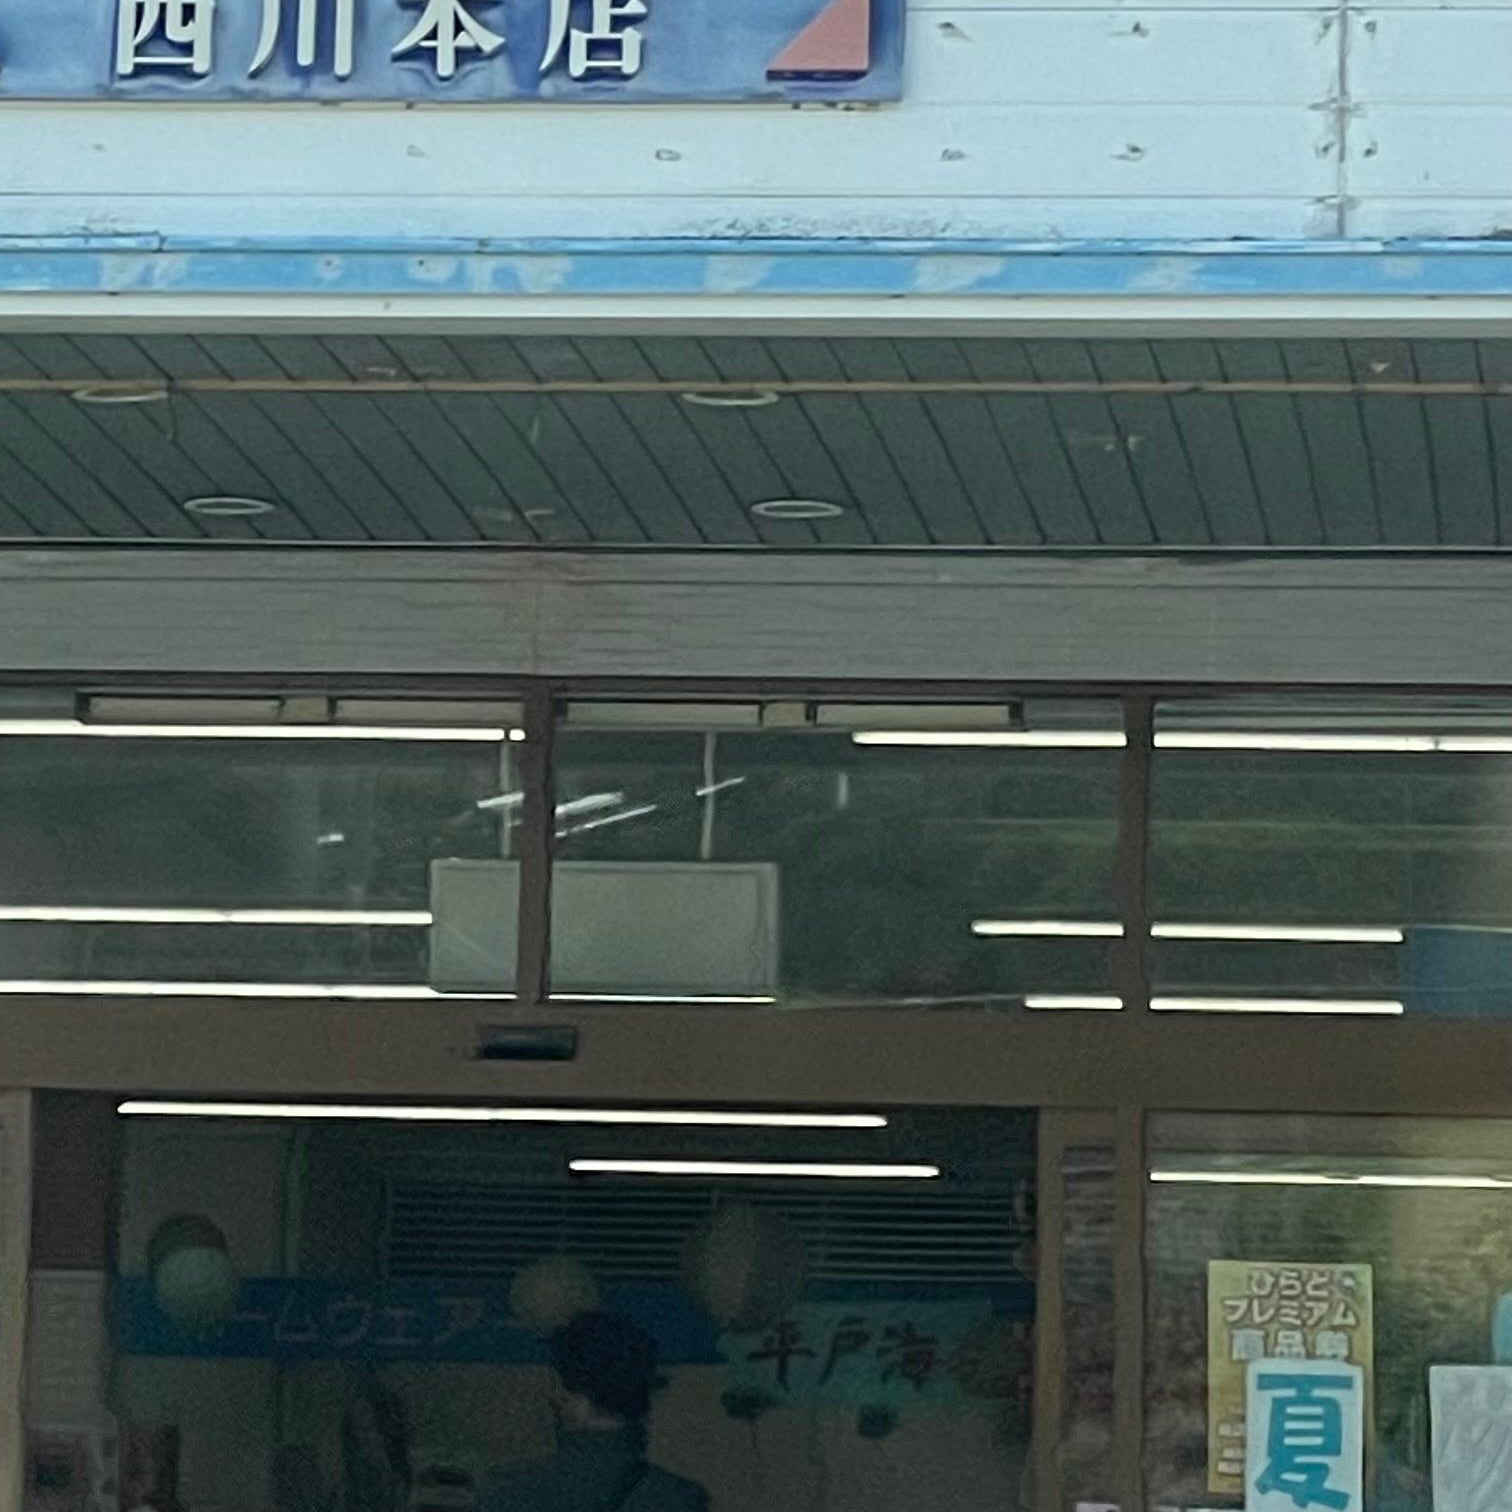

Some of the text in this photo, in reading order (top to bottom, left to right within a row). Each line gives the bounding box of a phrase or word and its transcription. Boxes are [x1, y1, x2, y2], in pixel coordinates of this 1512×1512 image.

[1223, 1298, 1359, 1327] プレミアム
[1254, 1373, 1354, 1511] 夏
